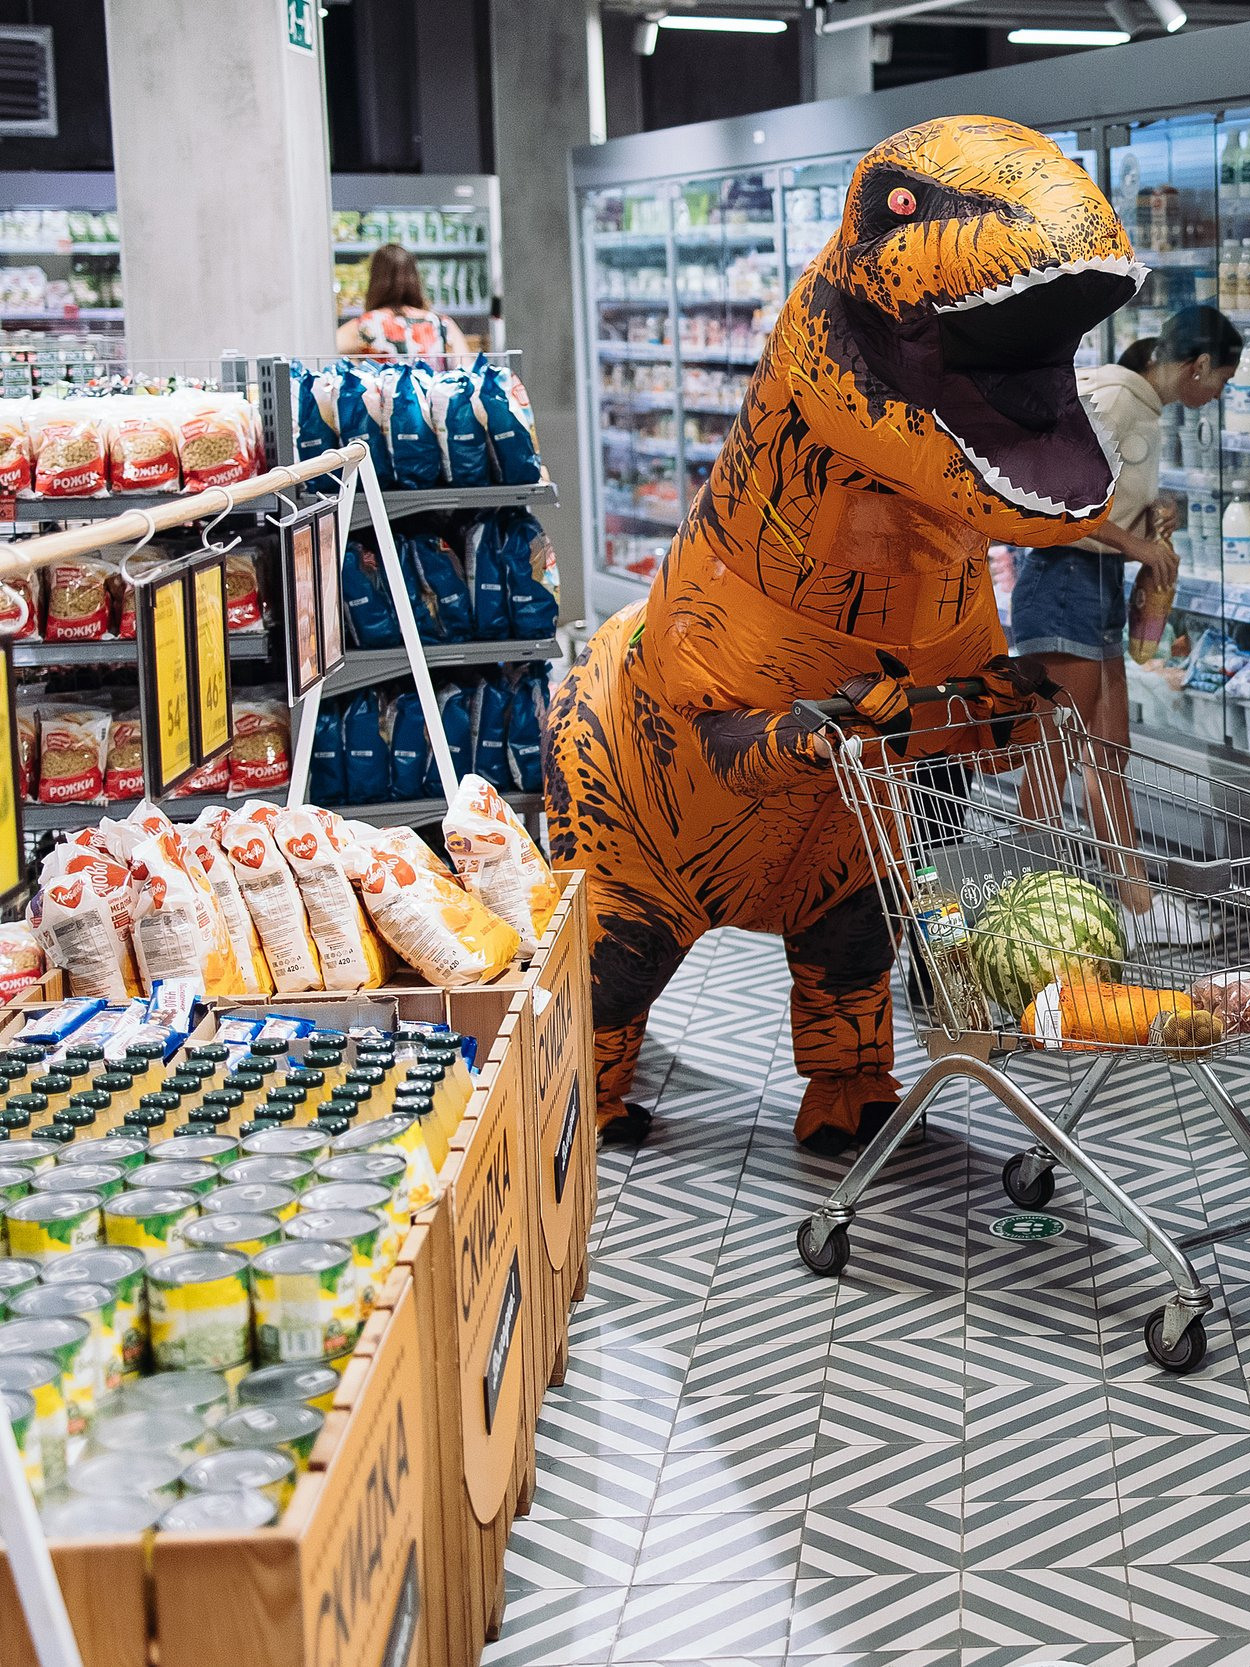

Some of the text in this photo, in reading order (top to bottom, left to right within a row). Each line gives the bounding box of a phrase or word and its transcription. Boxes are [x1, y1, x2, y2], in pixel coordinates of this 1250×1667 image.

[127, 463, 169, 479] ОЖКИ
[208, 465, 243, 485] ОЖКИ
[57, 623, 101, 639] РОЖКИ
[50, 778, 94, 798] РОЖКИ
[119, 775, 144, 790] РОЖ
[0, 976, 38, 992] ОЖКИ
[538, 970, 573, 1102] СКИДКА
[459, 1127, 512, 1323] СКИДКА
[313, 1396, 410, 1667] СКИДКА
